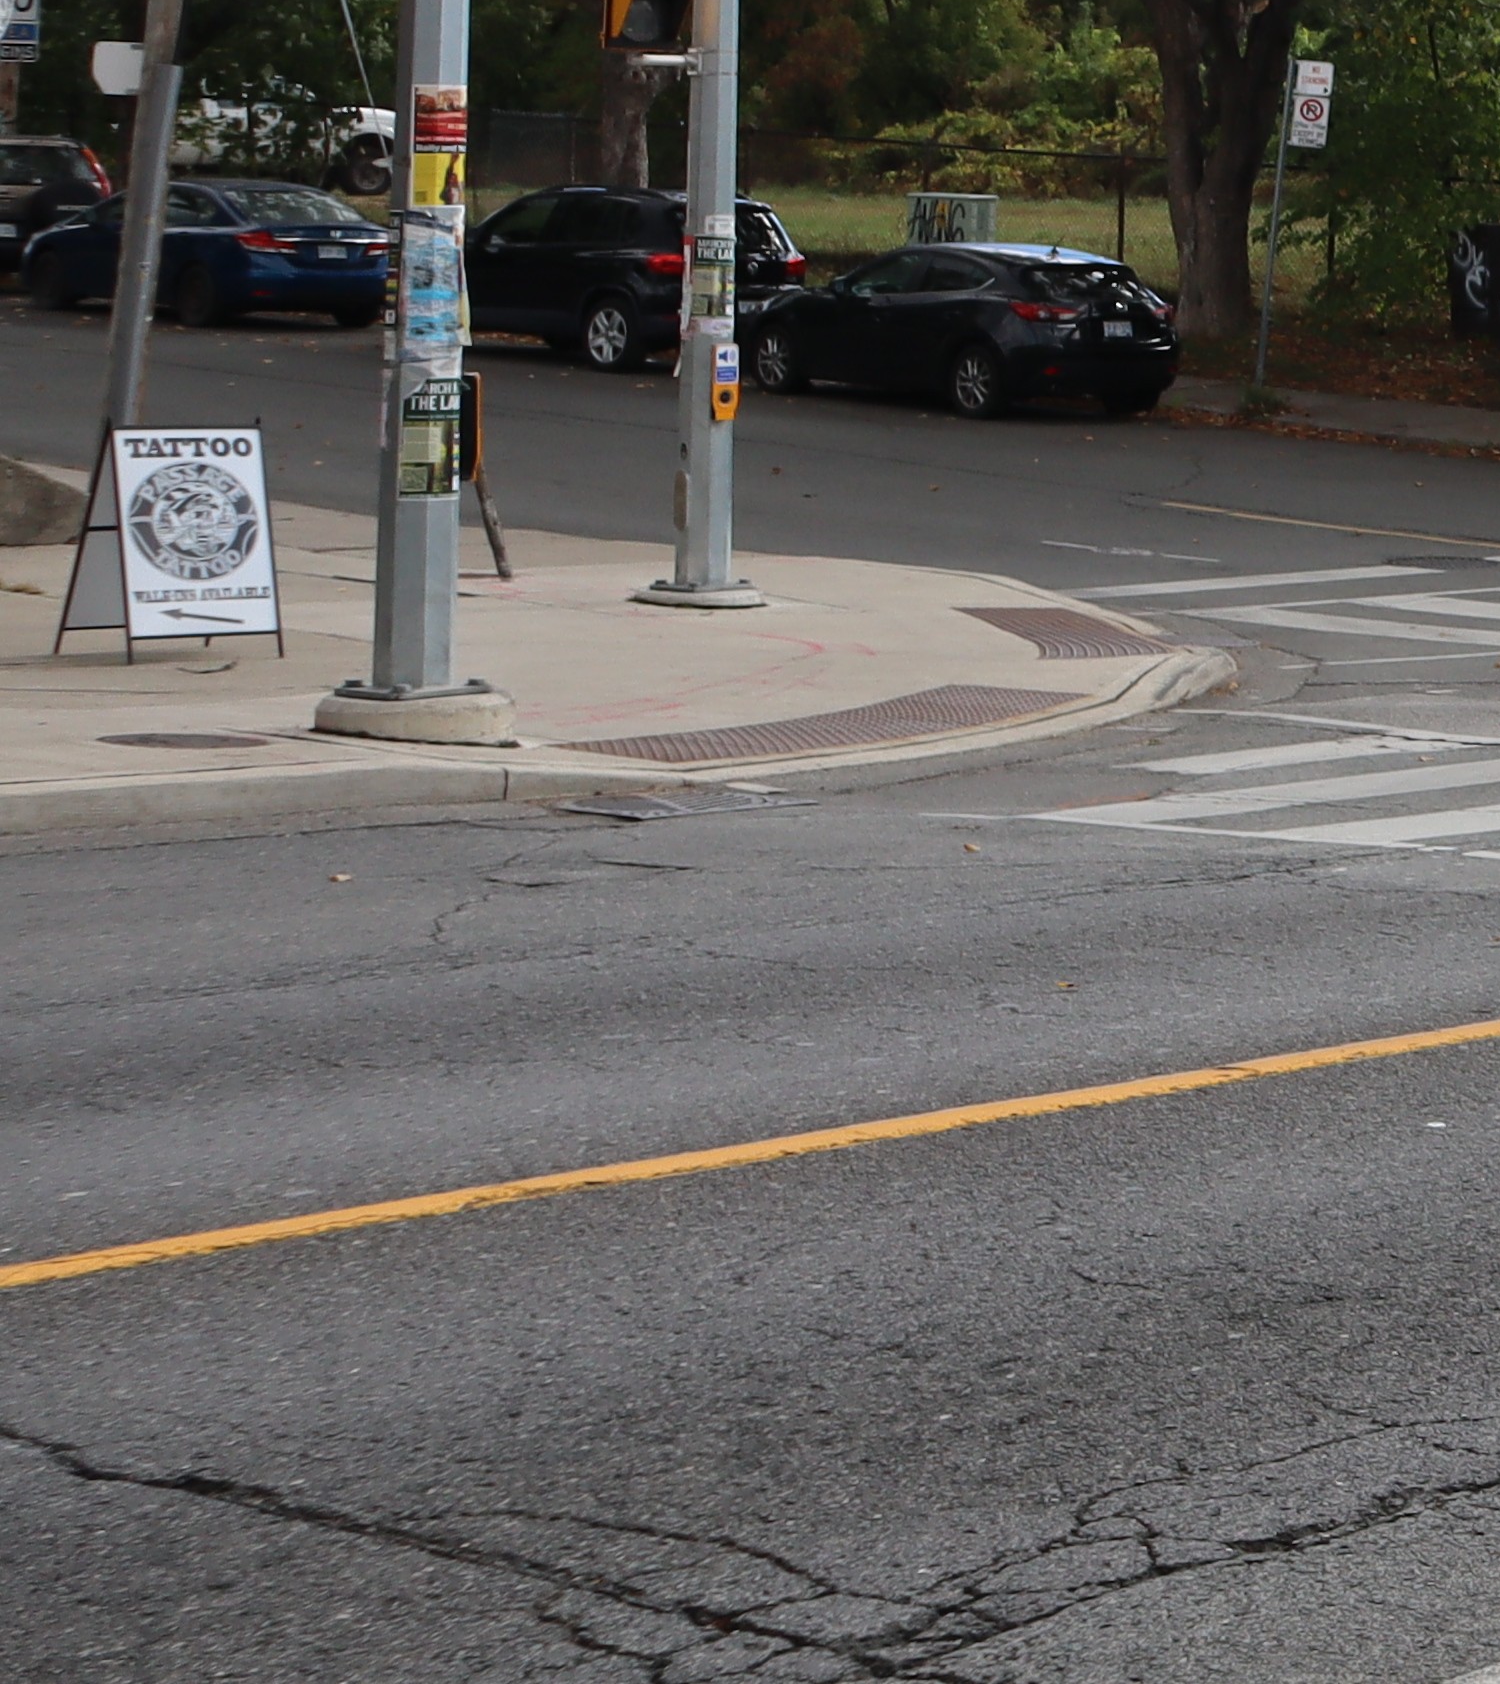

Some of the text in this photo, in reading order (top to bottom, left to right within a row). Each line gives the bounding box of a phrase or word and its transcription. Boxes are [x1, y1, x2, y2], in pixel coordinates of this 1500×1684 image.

[697, 248, 717, 260] THE
[410, 395, 437, 411] THE
[123, 437, 253, 458] TATTOO
[154, 548, 242, 579] TATTOO
